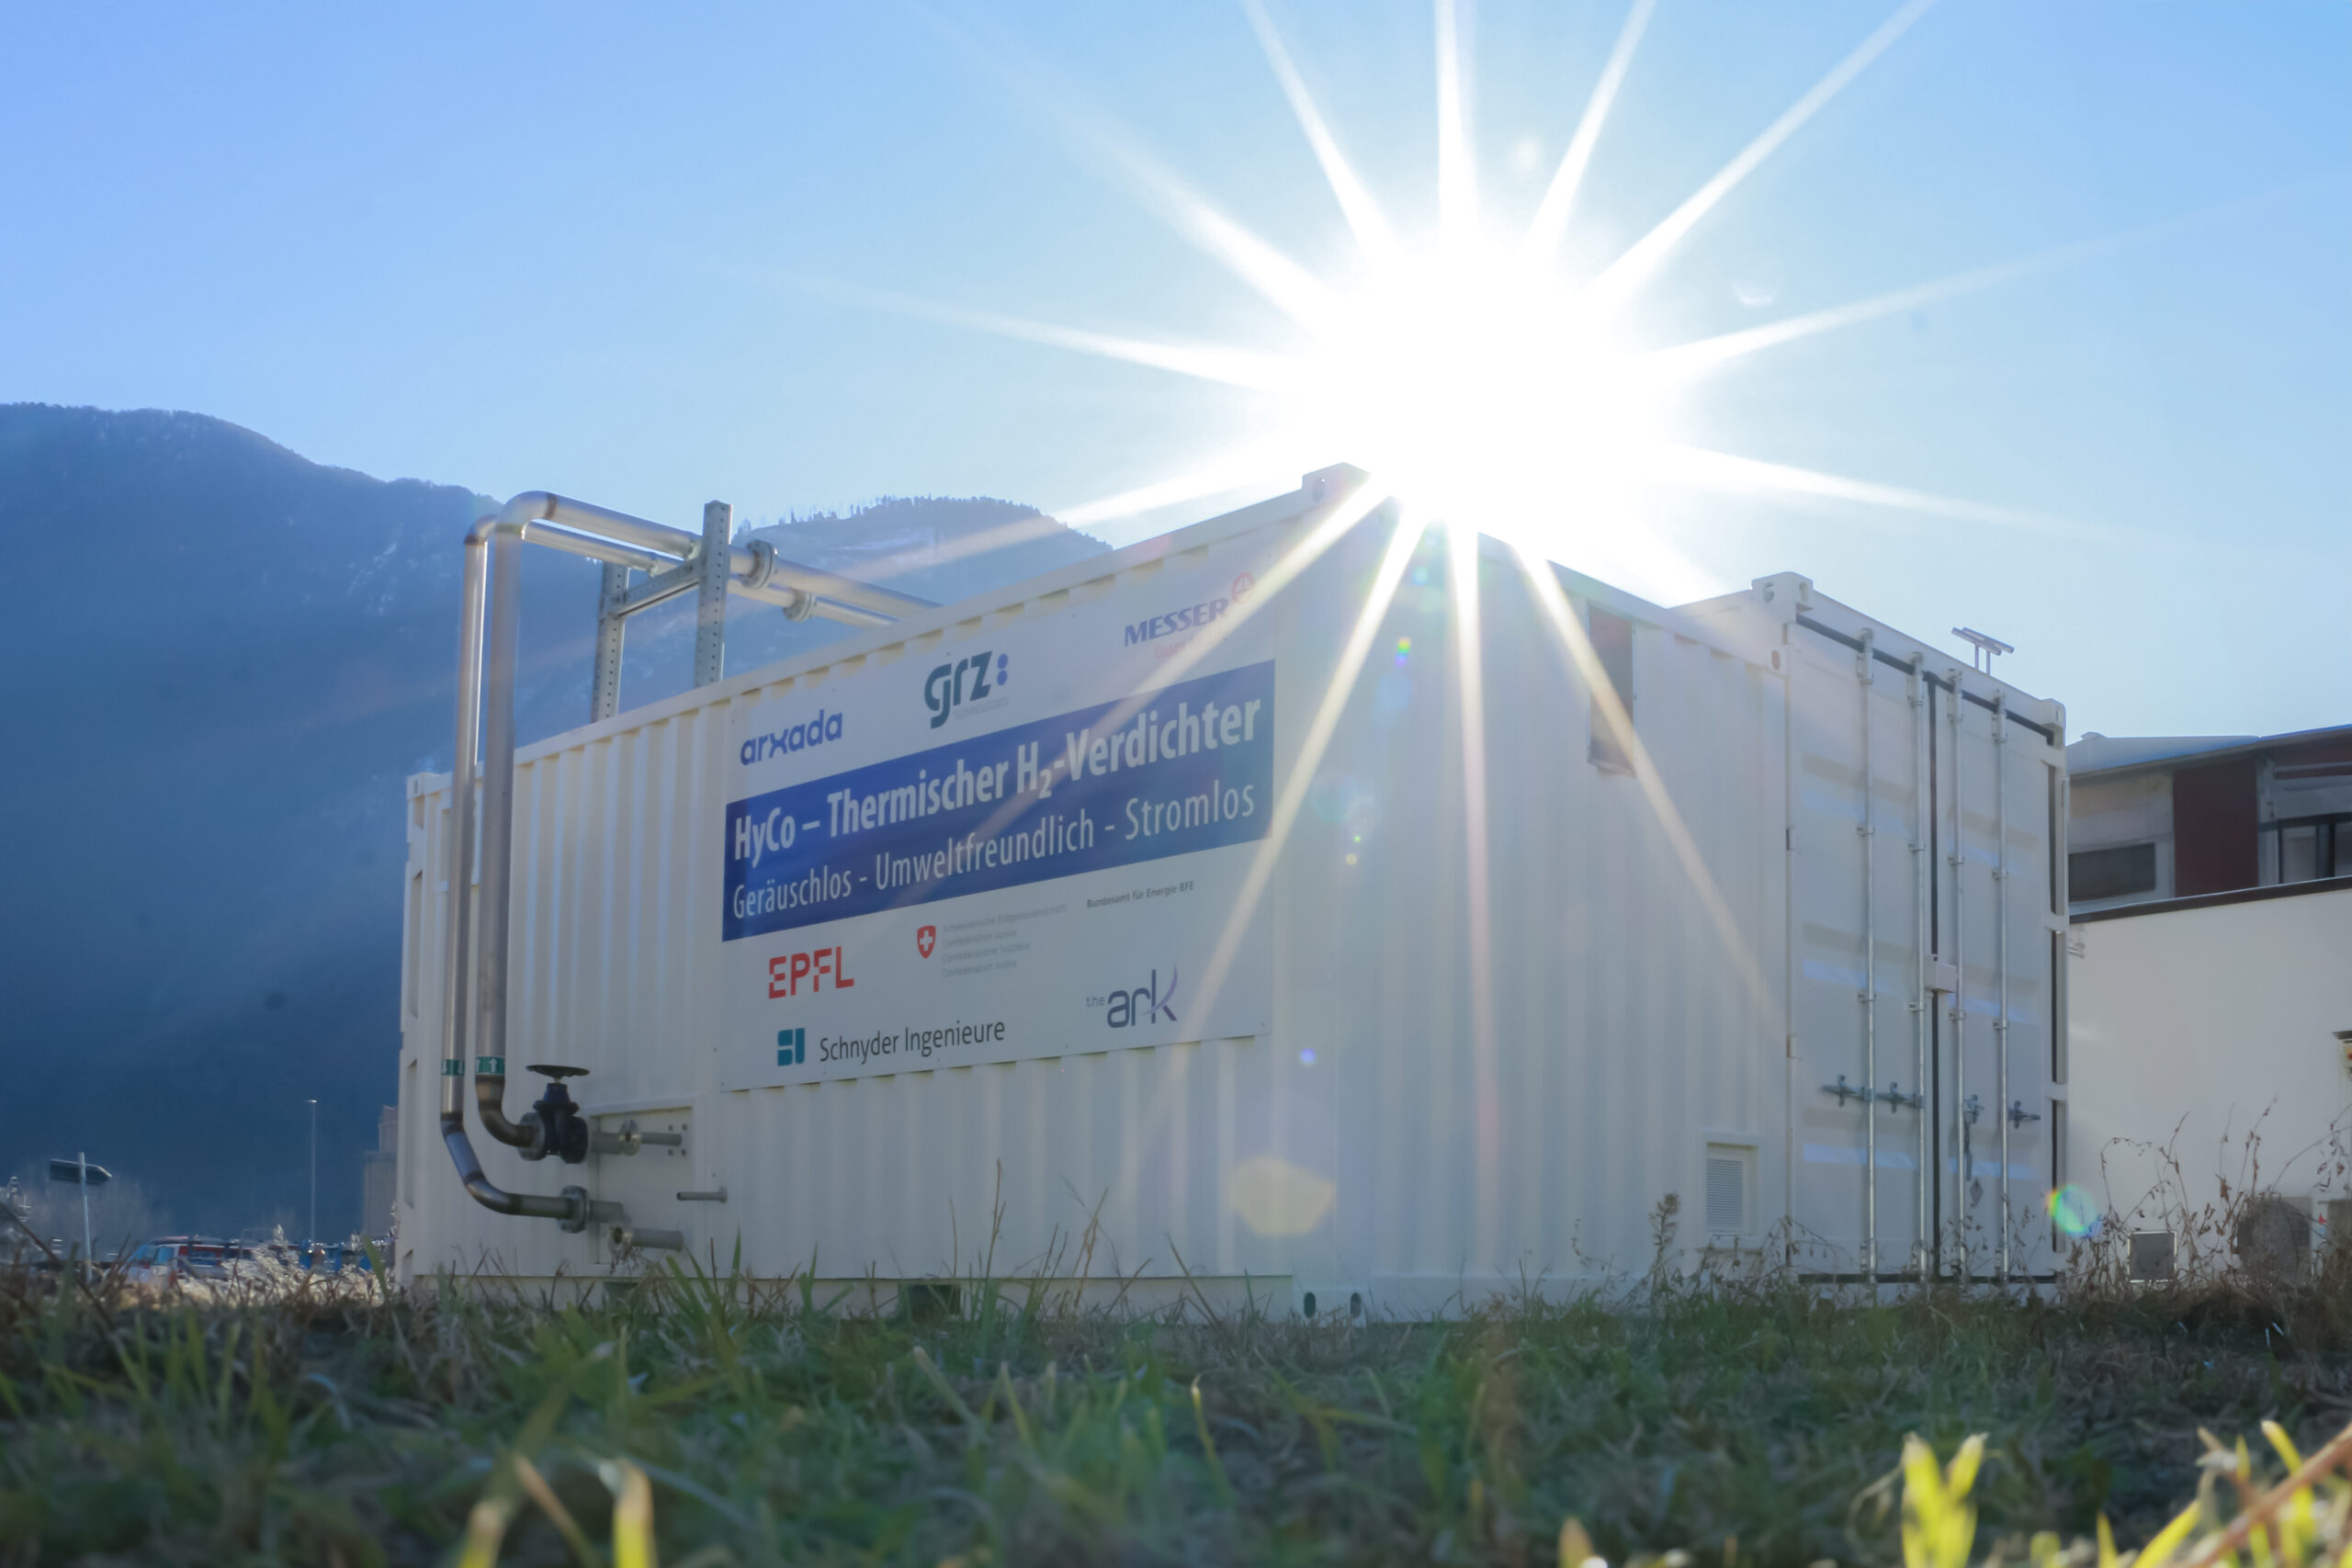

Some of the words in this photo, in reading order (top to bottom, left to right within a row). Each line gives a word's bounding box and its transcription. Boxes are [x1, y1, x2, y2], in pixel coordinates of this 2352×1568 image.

[1125, 598, 1229, 647] MESSER
[741, 709, 843, 765] arxada
[734, 807, 796, 869] HyCo
[827, 759, 1009, 838] Thermischer
[734, 865, 852, 919] Geräuschlos
[876, 808, 1094, 890] Umweltfreundlich
[1125, 779, 1255, 840] Stromlos
[1086, 893, 1131, 908] Bundesamt
[1132, 889, 1145, 900] für
[1147, 884, 1178, 897] Energie
[1180, 880, 1195, 893] BFE
[768, 946, 855, 998] EPFL
[1086, 995, 1106, 1008] the
[1107, 962, 1178, 1029] ark
[820, 1031, 899, 1065] Schnyder
[905, 1020, 1006, 1057] Ingenieure
